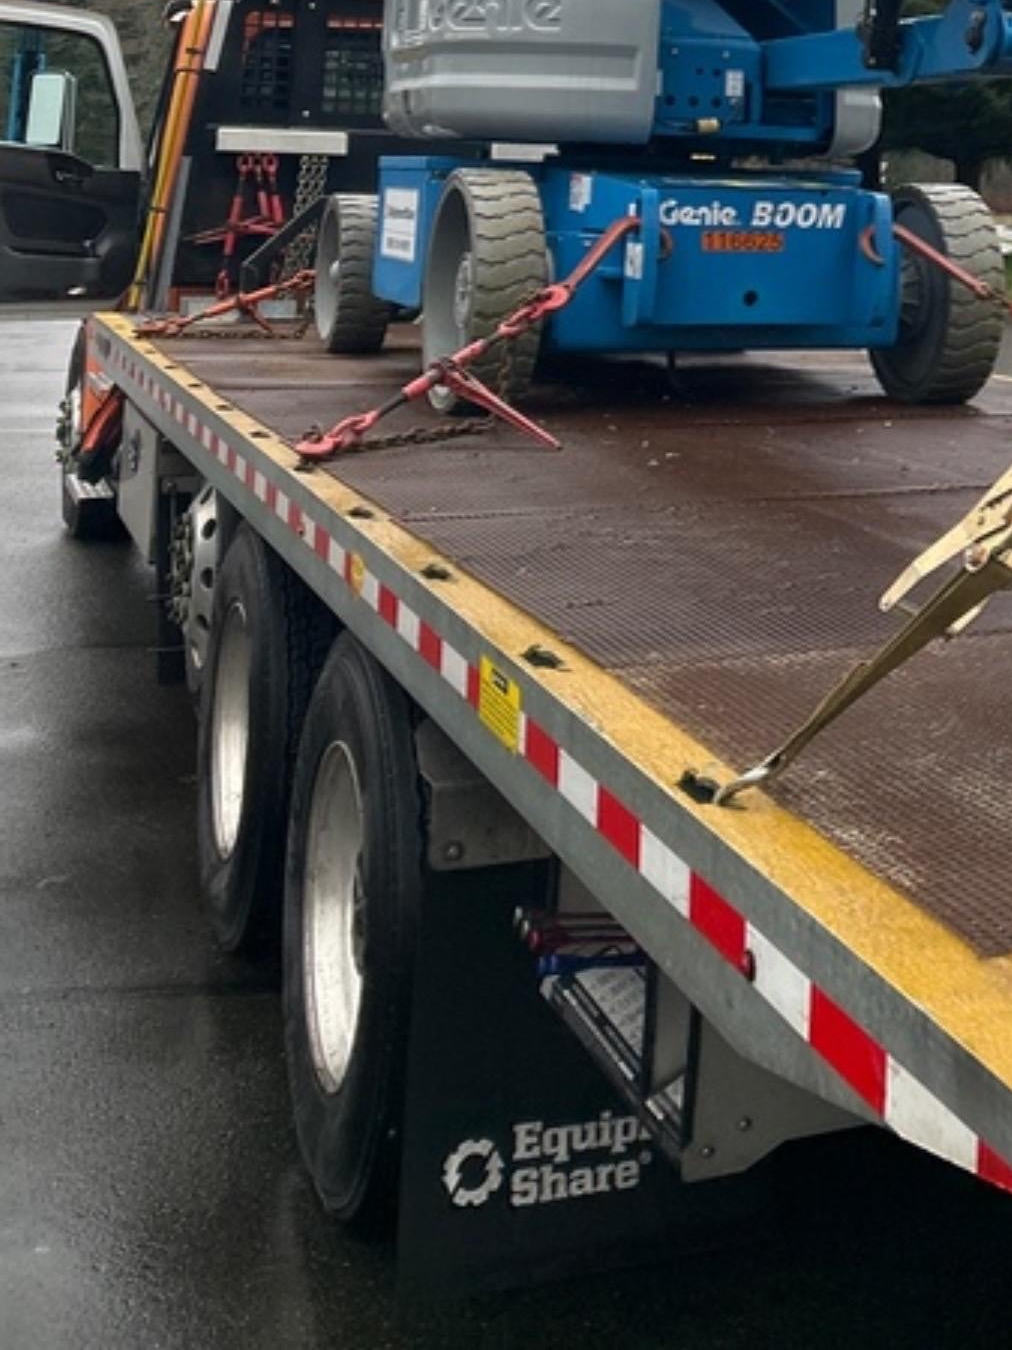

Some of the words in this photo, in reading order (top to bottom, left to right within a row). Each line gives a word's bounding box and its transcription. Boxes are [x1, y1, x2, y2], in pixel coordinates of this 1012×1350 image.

[658, 199, 737, 226] Genie
[751, 201, 847, 229] BOOM
[512, 1110, 652, 1163] Equip
[510, 1159, 641, 1207] Share
